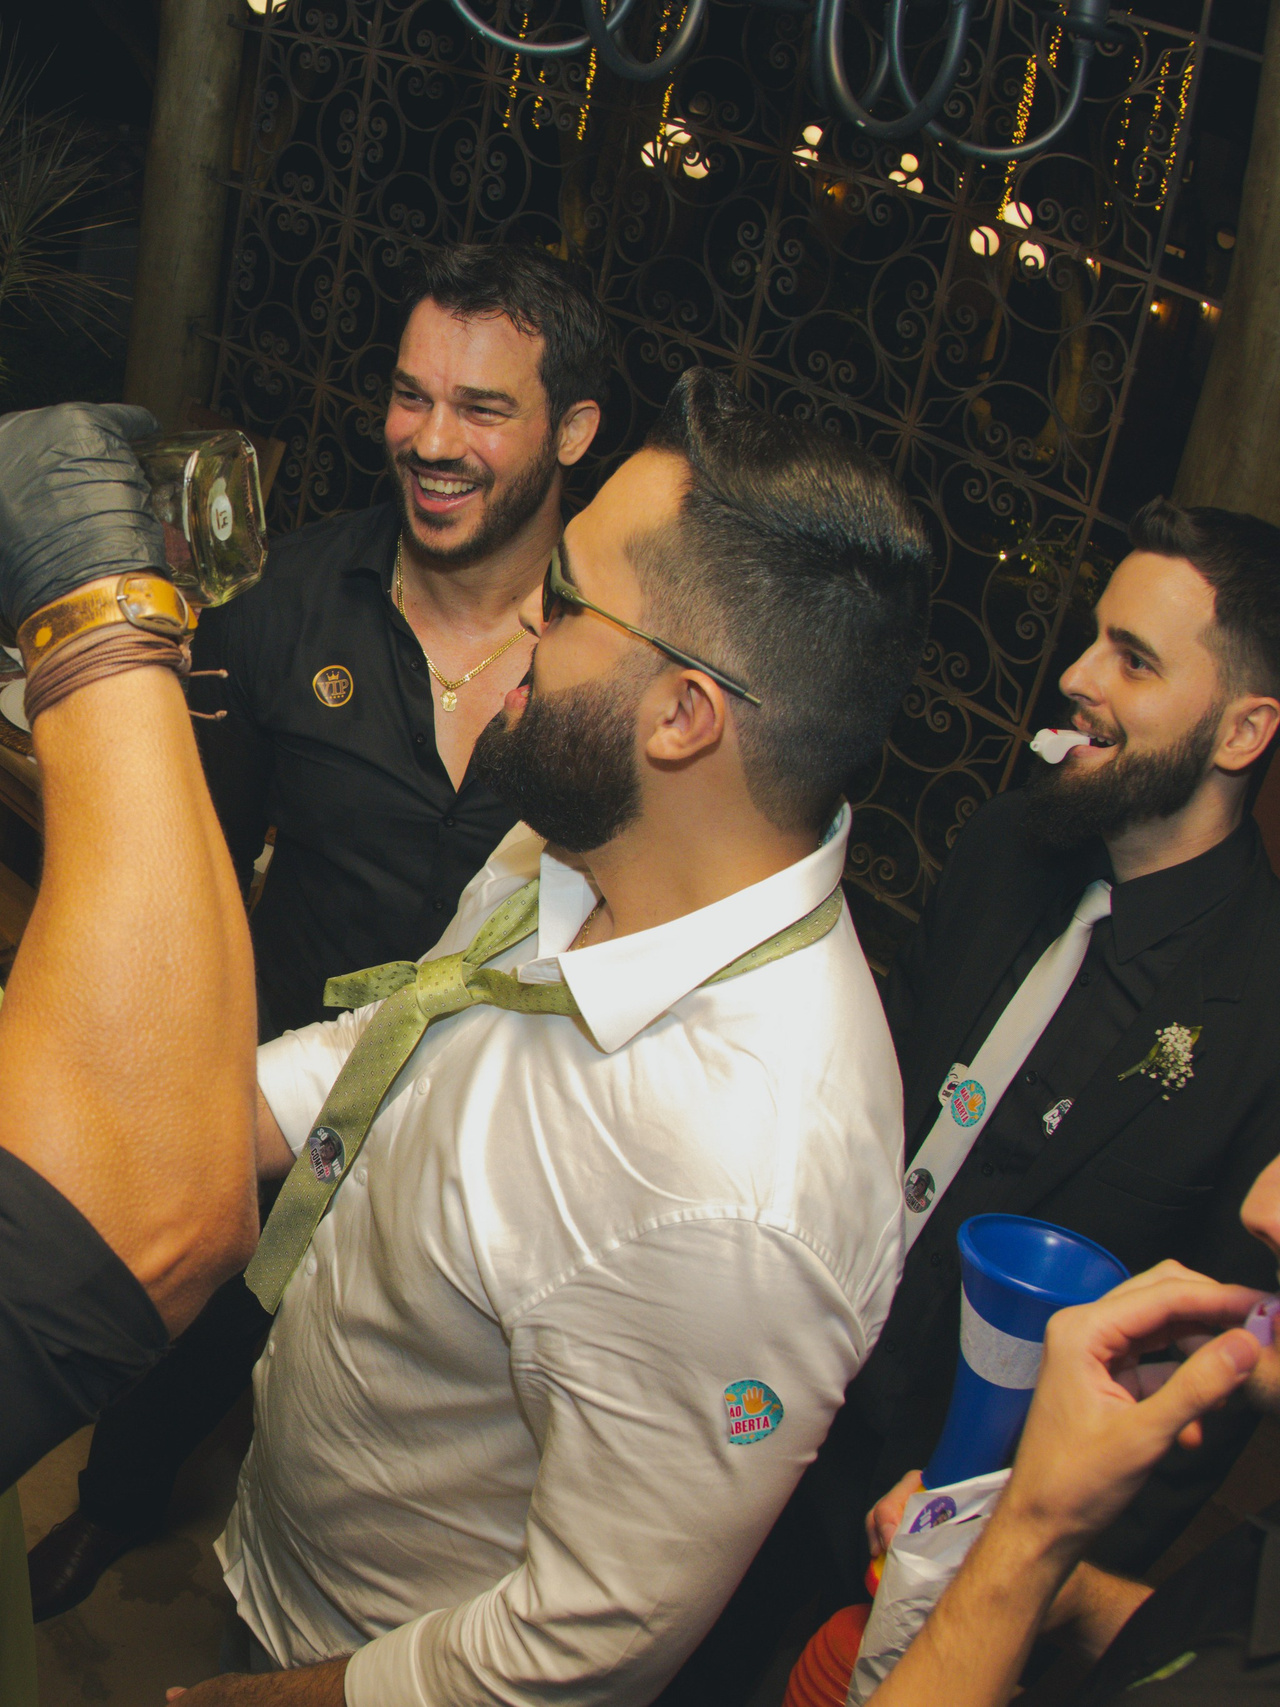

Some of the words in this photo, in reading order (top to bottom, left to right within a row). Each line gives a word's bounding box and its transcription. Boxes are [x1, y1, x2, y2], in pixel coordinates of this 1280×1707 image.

[317, 679, 350, 696] VIP
[953, 1097, 970, 1124] ABERTA
[317, 1128, 328, 1141] SÓ
[311, 1148, 324, 1177] COMER
